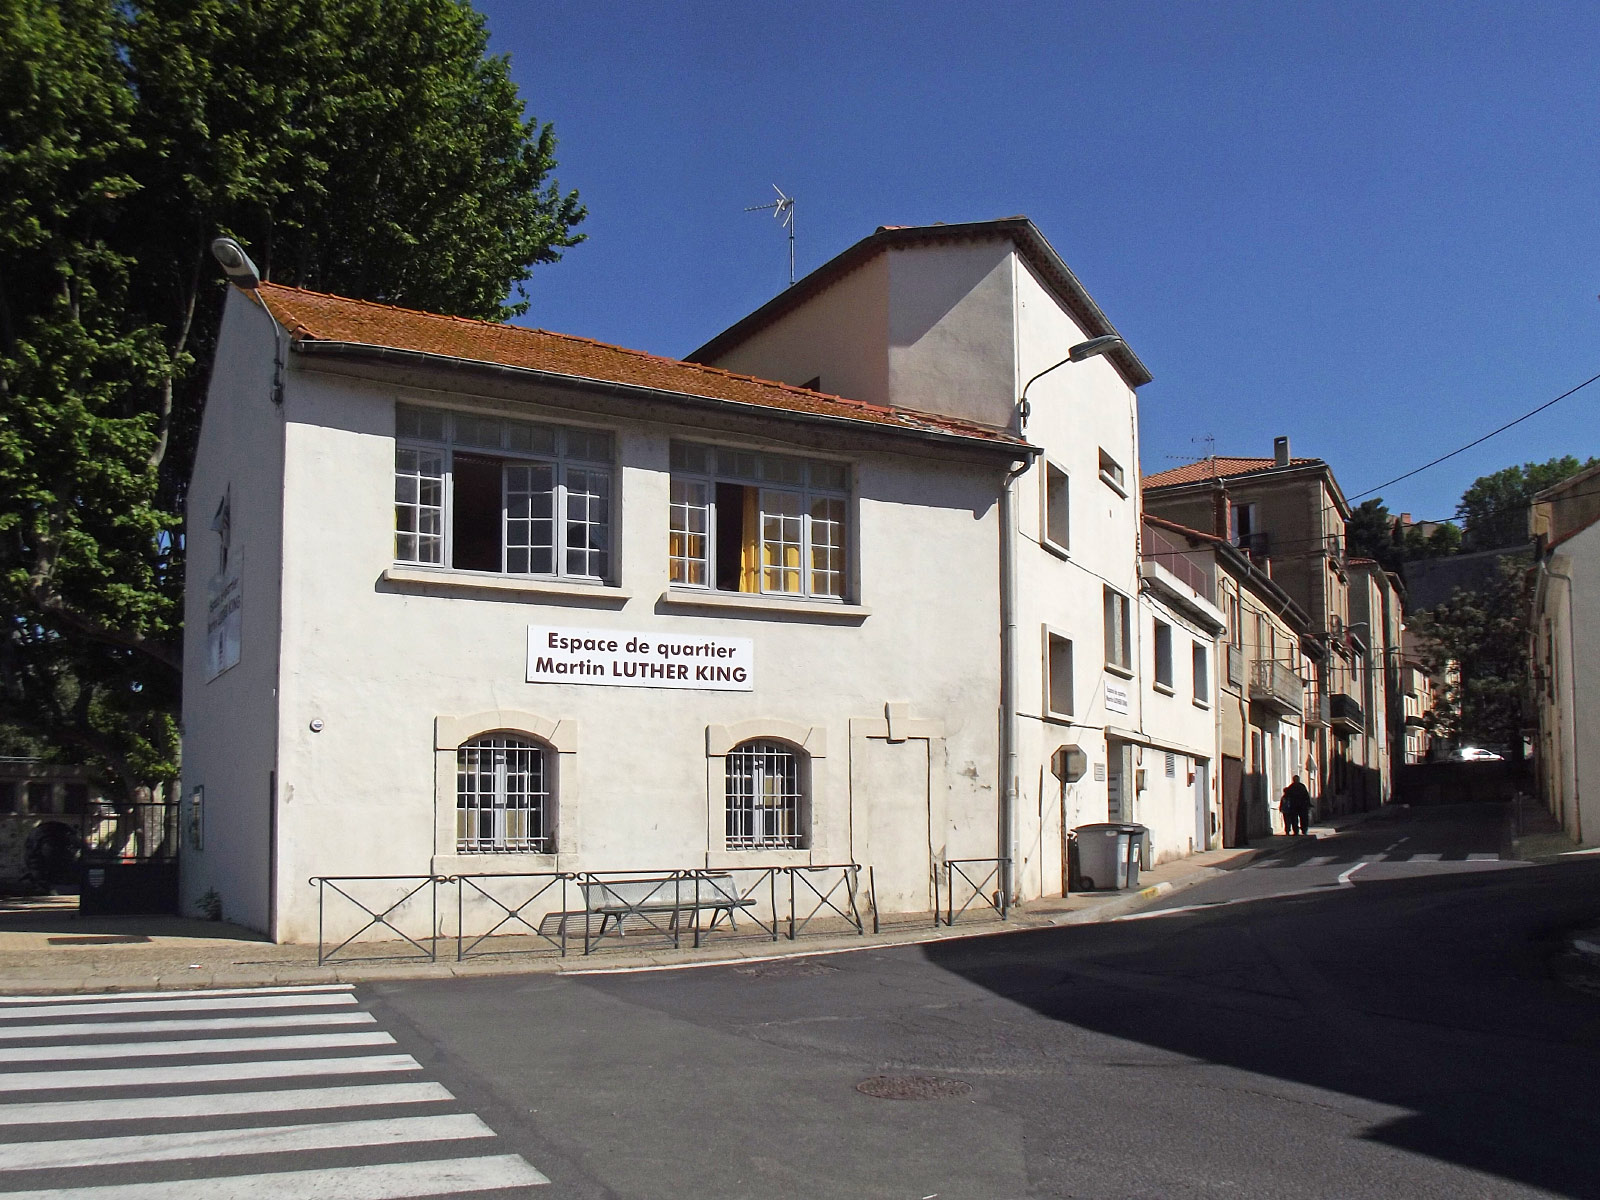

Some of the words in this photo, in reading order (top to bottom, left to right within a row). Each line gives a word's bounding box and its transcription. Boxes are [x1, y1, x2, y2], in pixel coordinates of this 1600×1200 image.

[548, 632, 619, 654] Espace
[625, 636, 650, 654] de
[657, 642, 737, 659] quartier
[535, 656, 605, 677] Martin
[612, 660, 689, 680] LUTHER
[695, 665, 747, 683] KING
